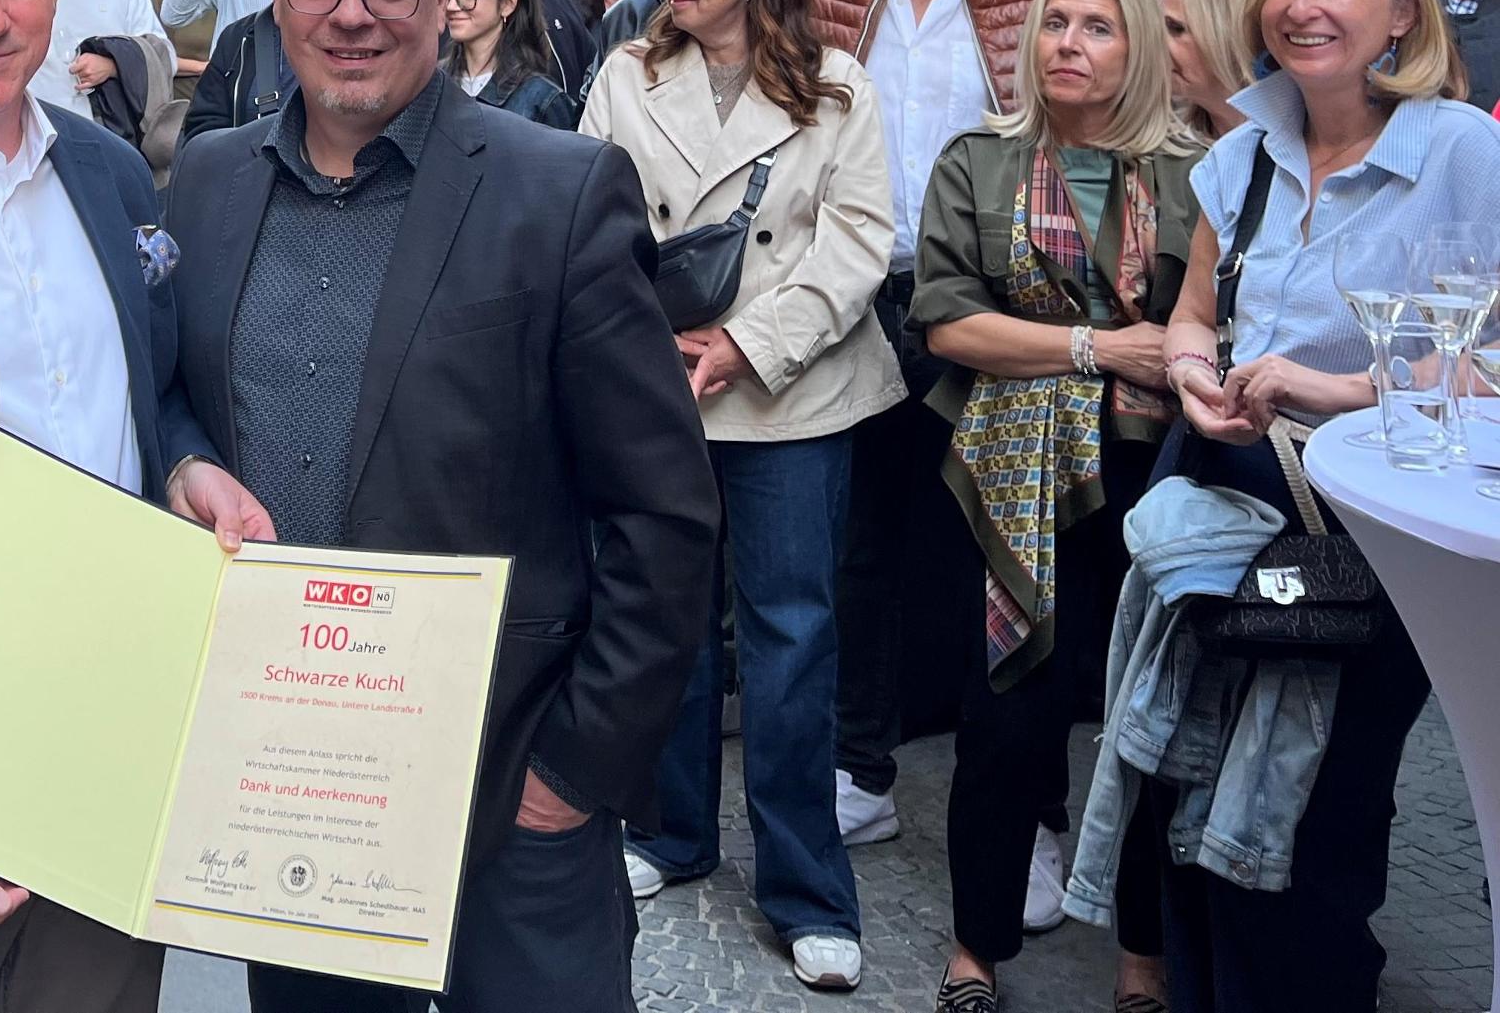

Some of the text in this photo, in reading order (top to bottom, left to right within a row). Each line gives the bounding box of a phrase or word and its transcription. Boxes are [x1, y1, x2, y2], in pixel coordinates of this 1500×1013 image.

[306, 582, 390, 605] WKO NÖ
[300, 623, 386, 654] 100 Jahre
[264, 664, 405, 692] Schwarze Kuchl
[259, 693, 283, 703] Krems
[297, 696, 310, 706] der
[341, 700, 369, 711] Untere
[371, 702, 415, 714] Landstraße
[262, 744, 378, 764] Aus diesem Anlass spricht die
[245, 759, 390, 783] Wirtschaftskammer Niederösterreich
[239, 778, 388, 810] Dank und Anerkennung
[239, 804, 380, 829] für die Leistungen im Interesse der
[228, 821, 383, 848] niederösterreichischen Wirtschaft aus.
[338, 897, 368, 907] Johannes
[358, 908, 385, 918] Direktor
